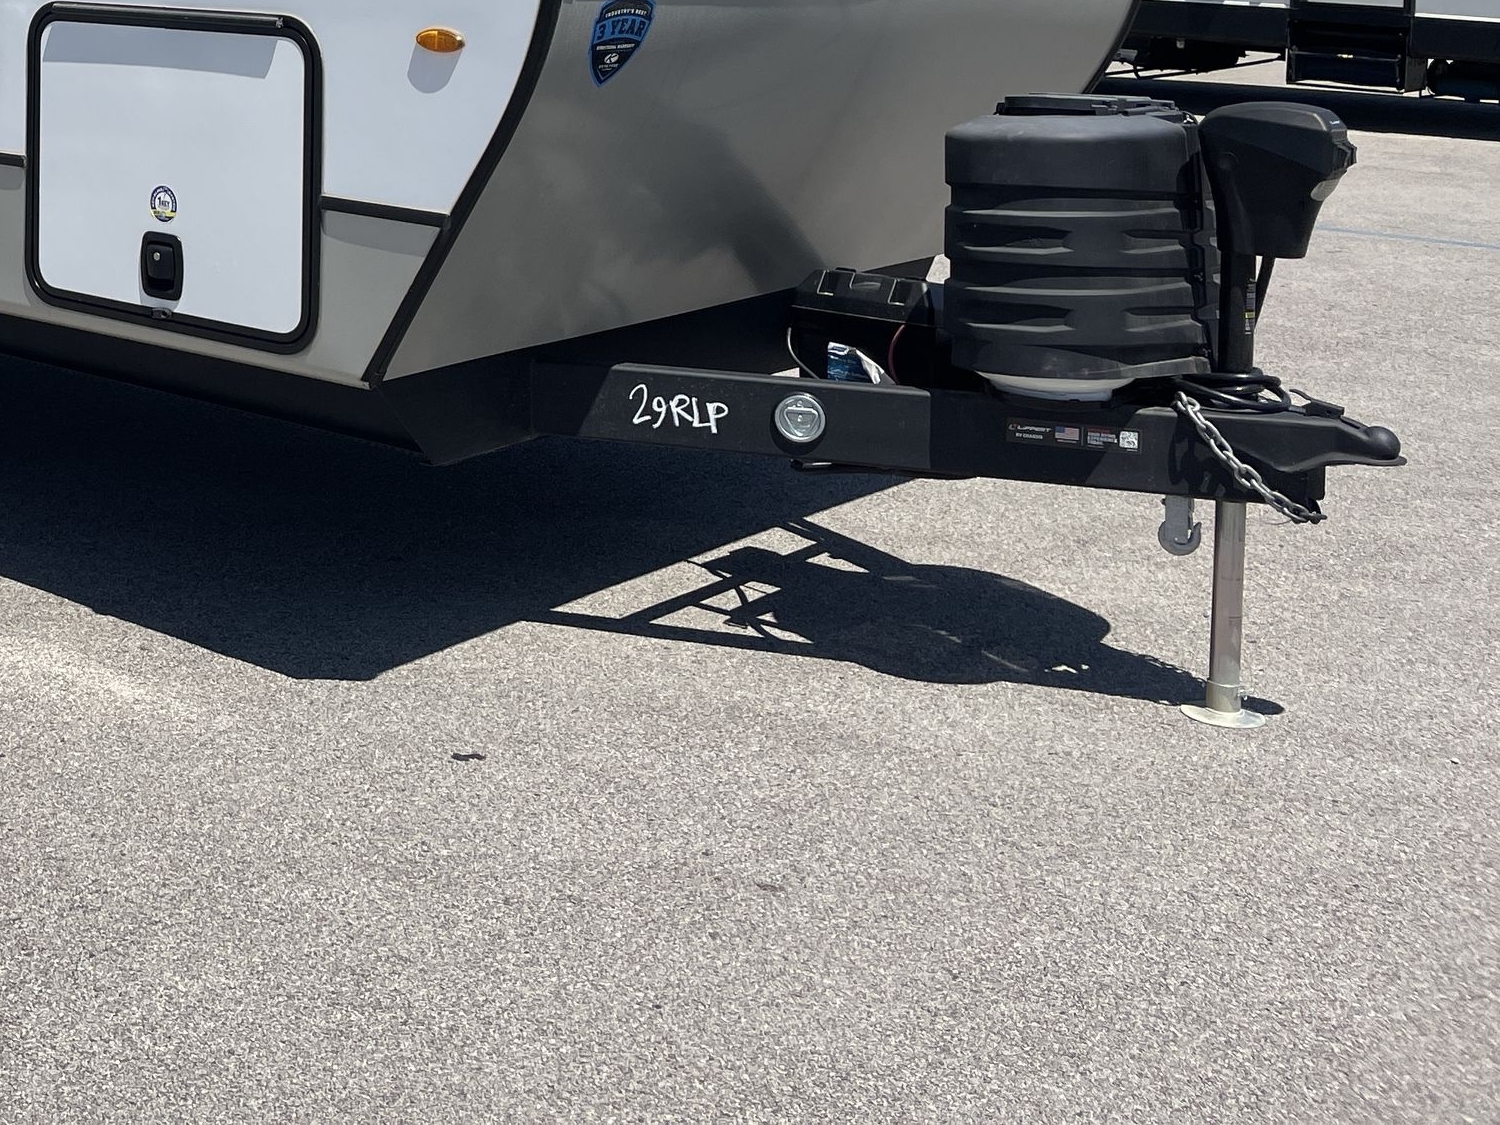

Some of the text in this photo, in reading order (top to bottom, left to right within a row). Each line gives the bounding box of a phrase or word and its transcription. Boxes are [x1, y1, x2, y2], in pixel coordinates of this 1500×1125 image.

[597, 18, 647, 41] 3 YEAR
[629, 383, 729, 434] 29RLP
